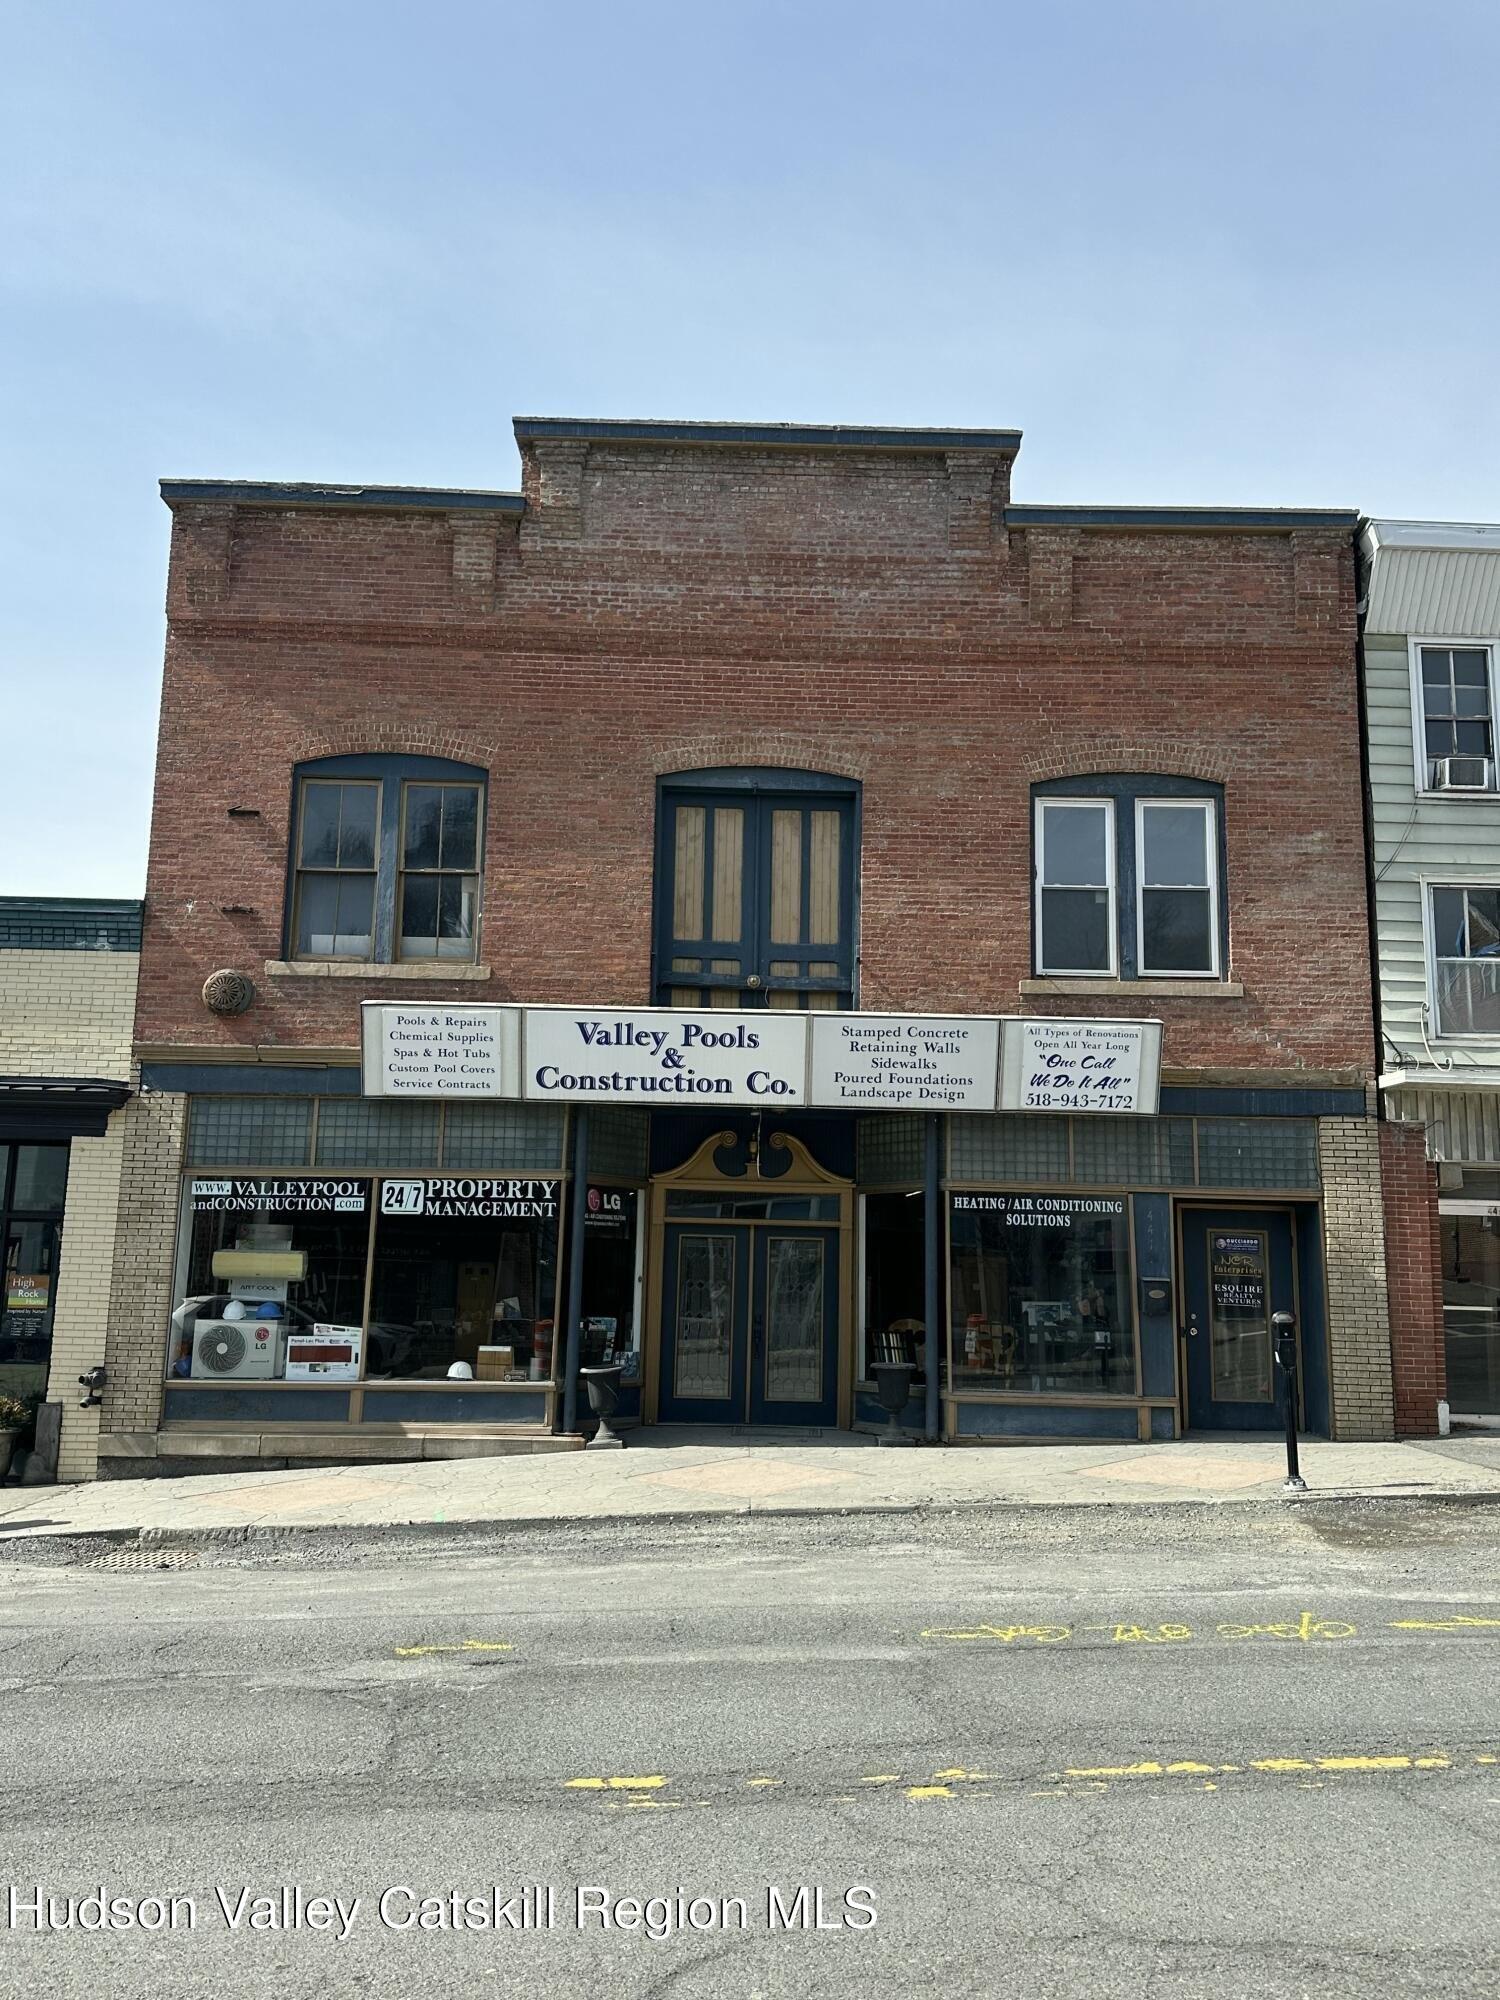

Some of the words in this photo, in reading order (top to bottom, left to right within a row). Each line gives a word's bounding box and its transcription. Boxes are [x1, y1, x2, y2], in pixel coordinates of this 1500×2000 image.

[397, 1016, 426, 1026] Pools
[431, 1017, 440, 1026] &
[445, 1017, 487, 1029] Repairs
[389, 1031, 443, 1042] Chemical
[447, 1032, 494, 1044] Supplies
[575, 1021, 669, 1055] Valley
[681, 1024, 759, 1049] Pools
[841, 1026, 902, 1040] Stamped
[907, 1028, 969, 1038] Concrete
[1028, 1028, 1040, 1036] All
[1044, 1029, 1069, 1039] Types
[1086, 1030, 1138, 1039] Renovations
[849, 1042, 917, 1055] Retaining
[924, 1043, 960, 1054] Walls
[1034, 1040, 1059, 1050] Open
[1082, 1042, 1101, 1050] Year
[1106, 1043, 1129, 1053] Long
[393, 1048, 419, 1060] Spas
[423, 1048, 433, 1058] &
[437, 1048, 458, 1058] Hot
[463, 1049, 490, 1059] Tubs
[661, 1047, 686, 1069] &
[388, 1064, 429, 1073] Custom
[434, 1064, 456, 1074] Pool
[461, 1065, 495, 1074] Covers
[871, 1058, 937, 1069] Sidewalks
[1081, 1056, 1116, 1069] Call
[393, 1078, 433, 1089] Service
[437, 1079, 490, 1089] Contracts
[535, 1066, 732, 1093] Construction
[746, 1071, 796, 1095] Co.
[834, 1072, 883, 1084] Poured
[888, 1073, 973, 1085] Foundations
[1030, 1073, 1051, 1088] We
[1053, 1075, 1075, 1088] Do
[1079, 1077, 1093, 1089] It
[840, 1087, 912, 1102] Landscape
[919, 1089, 965, 1102] Design
[1025, 1093, 1133, 1109] 518-943-7172
[235, 1181, 365, 1196] VALLEYPOOL
[386, 1185, 421, 1210] 24/7
[426, 1179, 556, 1199] PROPERTY
[190, 1197, 332, 1211] andCONSTRUCTION
[335, 1199, 362, 1210] .com
[603, 1194, 621, 1210] LG
[954, 1197, 1006, 1210] HEATING
[1013, 1199, 1033, 1210] AIR
[1036, 1200, 1122, 1213] CONDITIONING
[425, 1202, 556, 1217] MANAGEMENT
[1006, 1214, 1070, 1227] SOLUTIONS
[1214, 1265, 1262, 1274] Enterprises
[12, 1275, 35, 1289] High
[1214, 1283, 1263, 1293] ESQUIRE
[18, 1289, 39, 1298] Rock
[255, 1342, 267, 1350] LG
